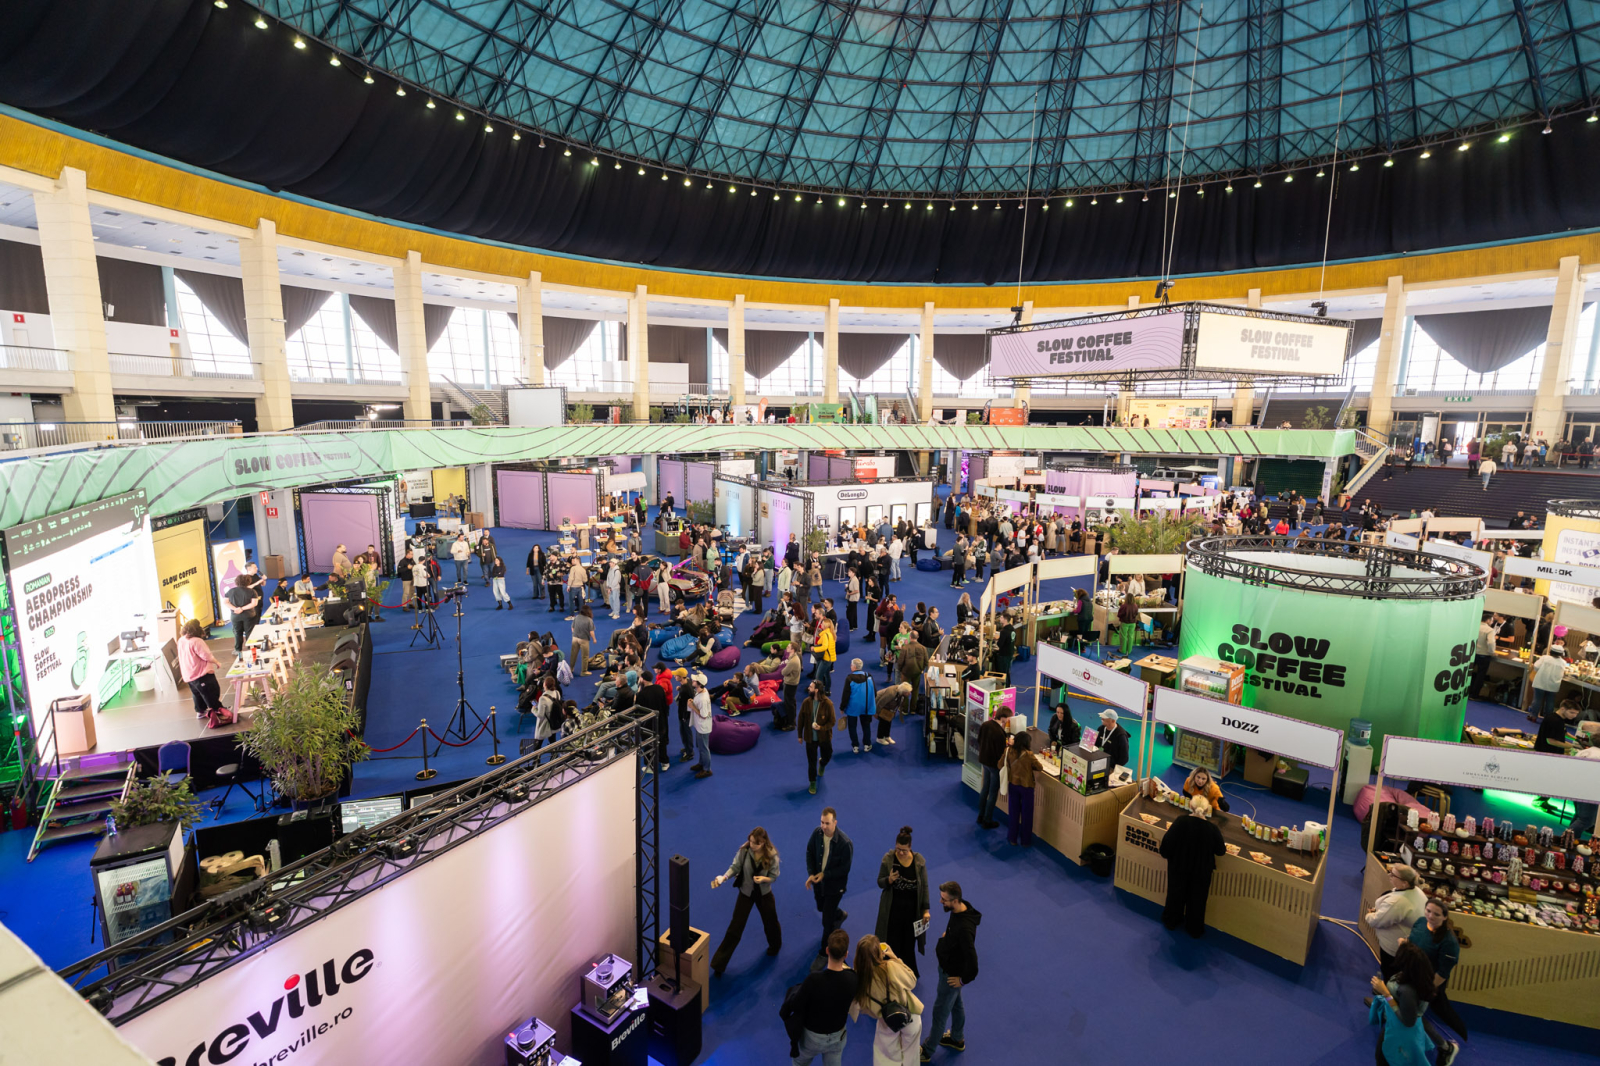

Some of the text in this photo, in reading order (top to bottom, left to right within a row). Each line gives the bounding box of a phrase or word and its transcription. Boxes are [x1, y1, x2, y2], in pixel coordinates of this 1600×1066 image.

[1037, 331, 1132, 353] SLOW COFFEE
[1240, 328, 1314, 349] SLOW COFFEE
[1049, 347, 1114, 365] FESTIVAL
[1250, 344, 1300, 361] FESTIVAL
[234, 456, 271, 475] SLOW
[275, 452, 322, 470] COFFEE
[1047, 484, 1067, 494] SLOW
[25, 574, 51, 593] ROMANIAN
[162, 566, 197, 587] SLOW COFFEE
[173, 579, 190, 589] FESTIVAL
[26, 575, 80, 615] AEROPRESS
[28, 583, 93, 631] CHAMPIONSHIP
[1231, 623, 1331, 660] SLOW
[33, 646, 50, 662] SLOW
[35, 652, 56, 671] COFFEE
[37, 659, 62, 681] FESTIVAL
[1217, 642, 1347, 688] COFFEE
[1244, 673, 1322, 699] ESTIVAL
[1221, 716, 1260, 734] DOZZ
[1126, 825, 1150, 838] SLOW
[1126, 831, 1157, 847] COFFEE
[1125, 836, 1160, 854] FESTIVA
[157, 948, 374, 1066] reville
[611, 1012, 646, 1051] Breville
